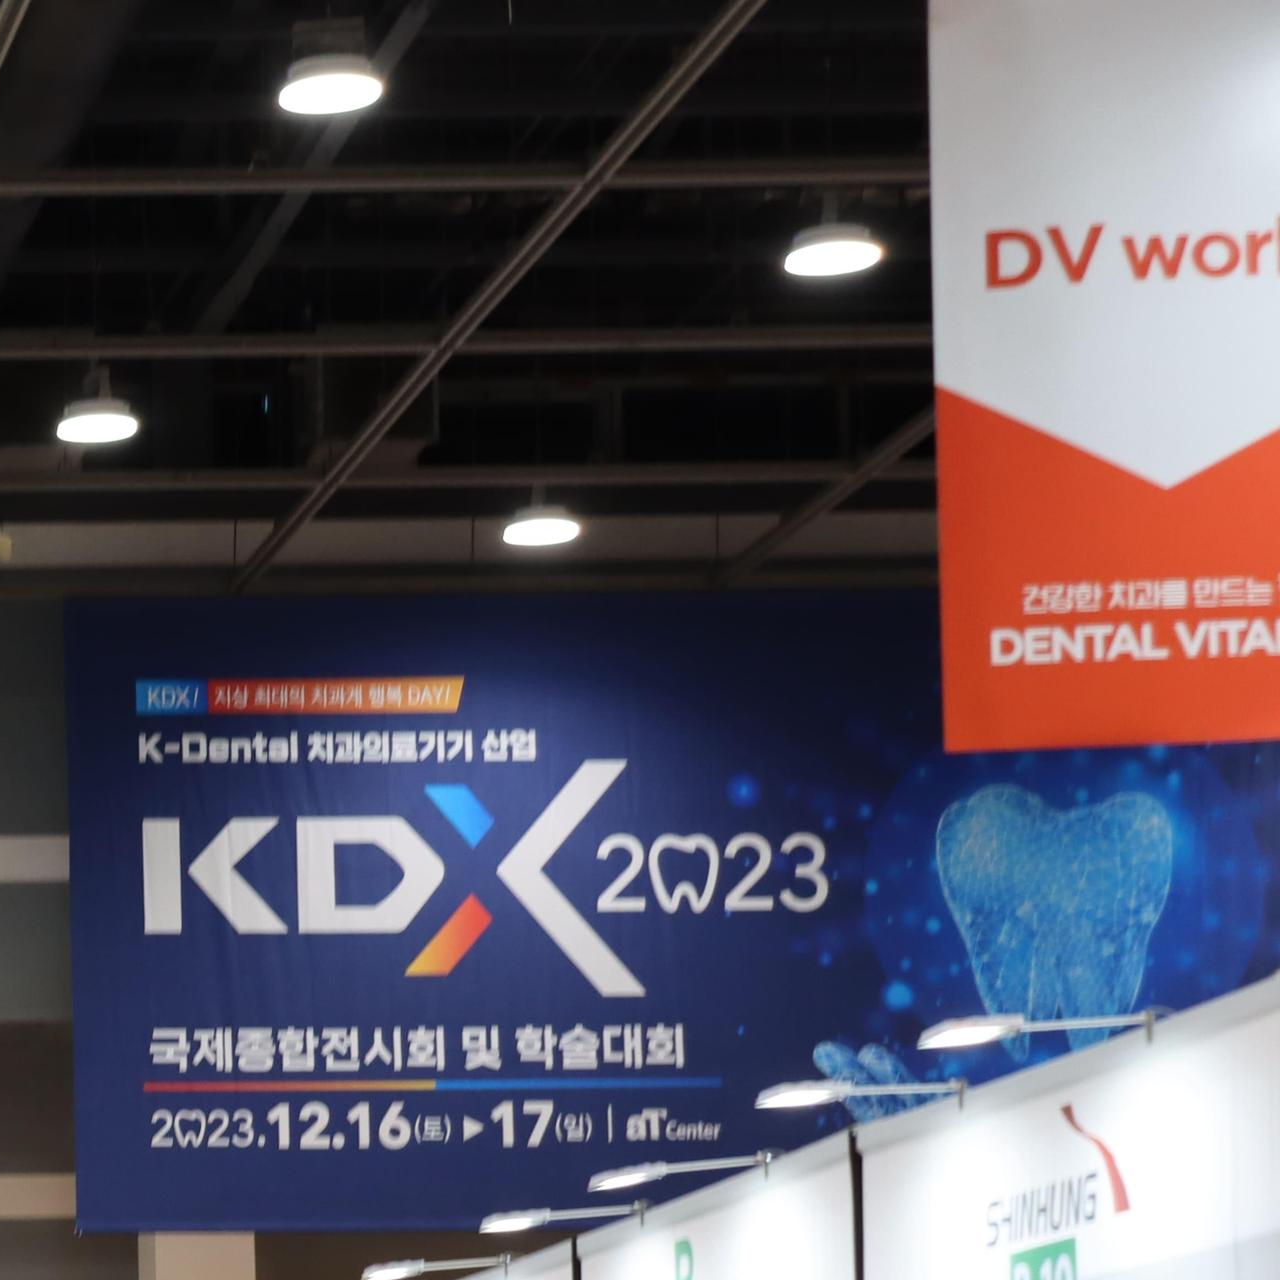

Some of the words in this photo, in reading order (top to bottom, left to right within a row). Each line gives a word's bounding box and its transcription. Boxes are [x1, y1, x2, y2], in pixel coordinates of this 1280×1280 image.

[984, 223, 1104, 291] DV
[1023, 581, 1102, 615] 건강한
[1108, 577, 1188, 610] 치과를
[1193, 576, 1273, 608] 만드는
[990, 622, 1170, 667] DENTAL
[138, 730, 298, 764] K-Dental
[307, 729, 473, 764] 치과의료기기
[482, 728, 537, 763] 산업
[142, 758, 645, 997] KDX
[595, 832, 829, 914] 2023
[148, 1025, 446, 1073] 국제종합전시회
[462, 1025, 502, 1071] 및
[515, 1023, 686, 1070] 학술대회
[986, 1173, 1098, 1248] SHINHUNG
